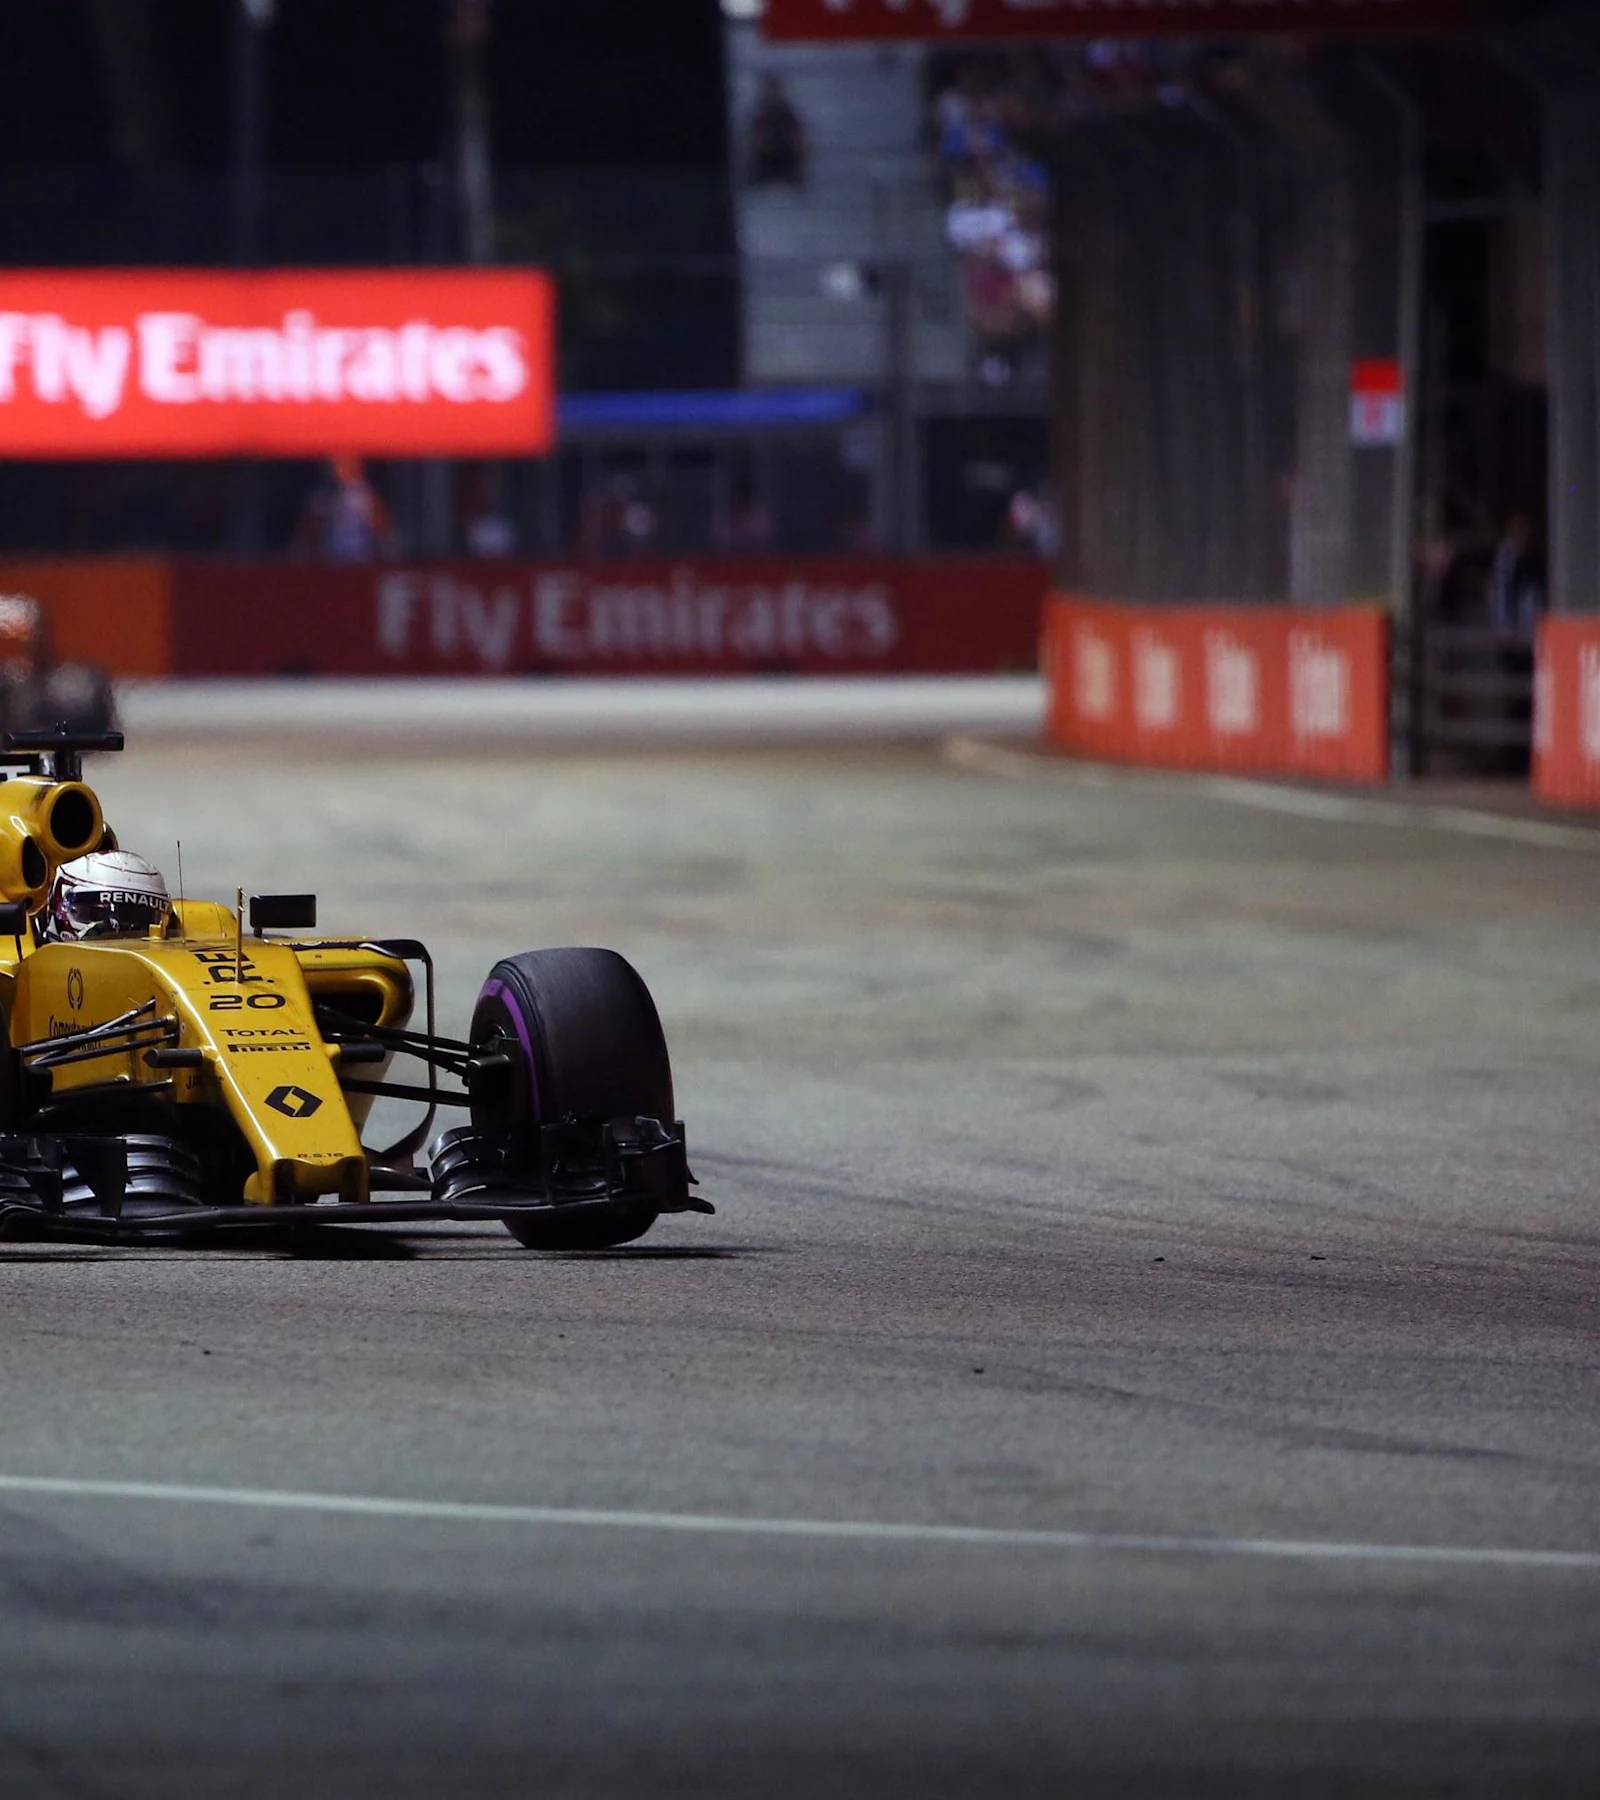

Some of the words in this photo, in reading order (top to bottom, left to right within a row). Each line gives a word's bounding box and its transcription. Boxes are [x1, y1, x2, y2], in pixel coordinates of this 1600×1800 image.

[137, 309, 529, 403] Emirates
[377, 571, 519, 668] Fly
[532, 567, 897, 656] Emirates
[100, 891, 170, 913] RENAULT
[209, 993, 286, 1010] 20
[220, 1029, 305, 1037] TOTAL
[227, 1042, 311, 1053] PIRELLI
